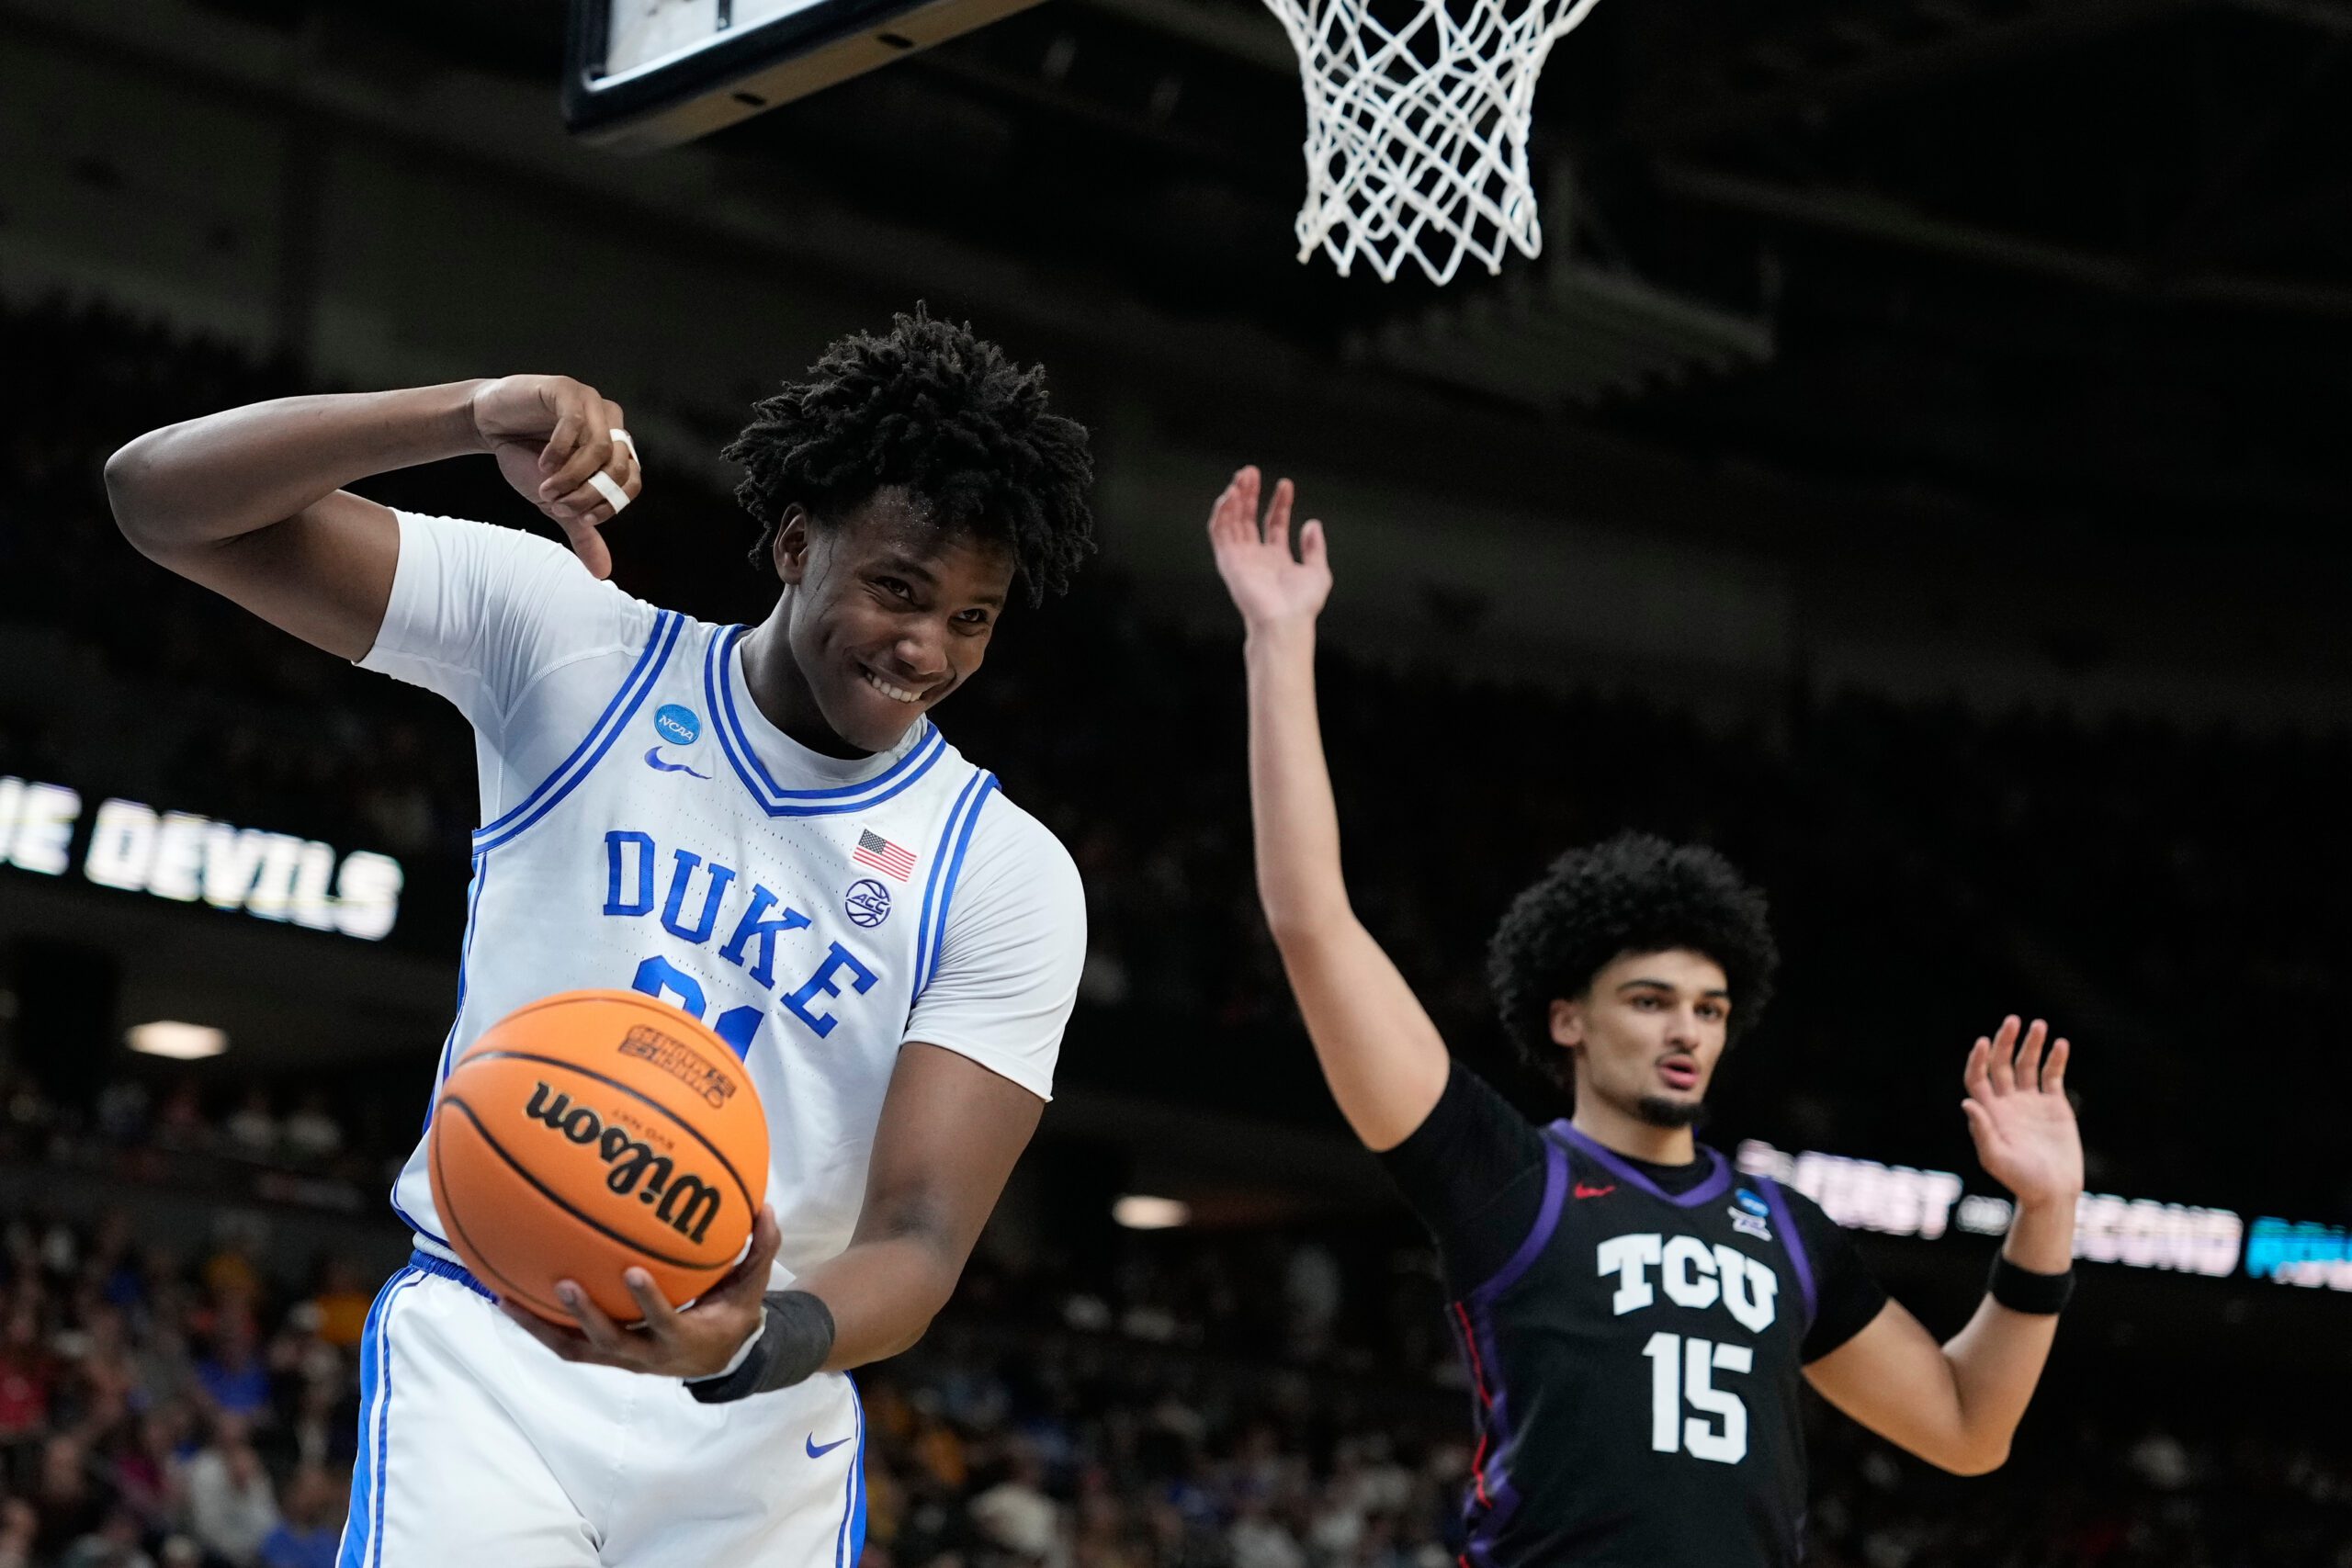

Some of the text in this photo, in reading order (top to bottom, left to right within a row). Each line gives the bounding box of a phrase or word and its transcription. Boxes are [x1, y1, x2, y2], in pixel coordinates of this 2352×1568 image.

[659, 714, 695, 741] NCAA
[85, 797, 403, 942] DEVILS
[603, 829, 879, 1039] DUKE
[851, 893, 890, 913] ACC
[523, 1080, 722, 1246] Wilson
[1597, 1233, 1779, 1334] TCU
[1641, 1331, 1754, 1465] 15
